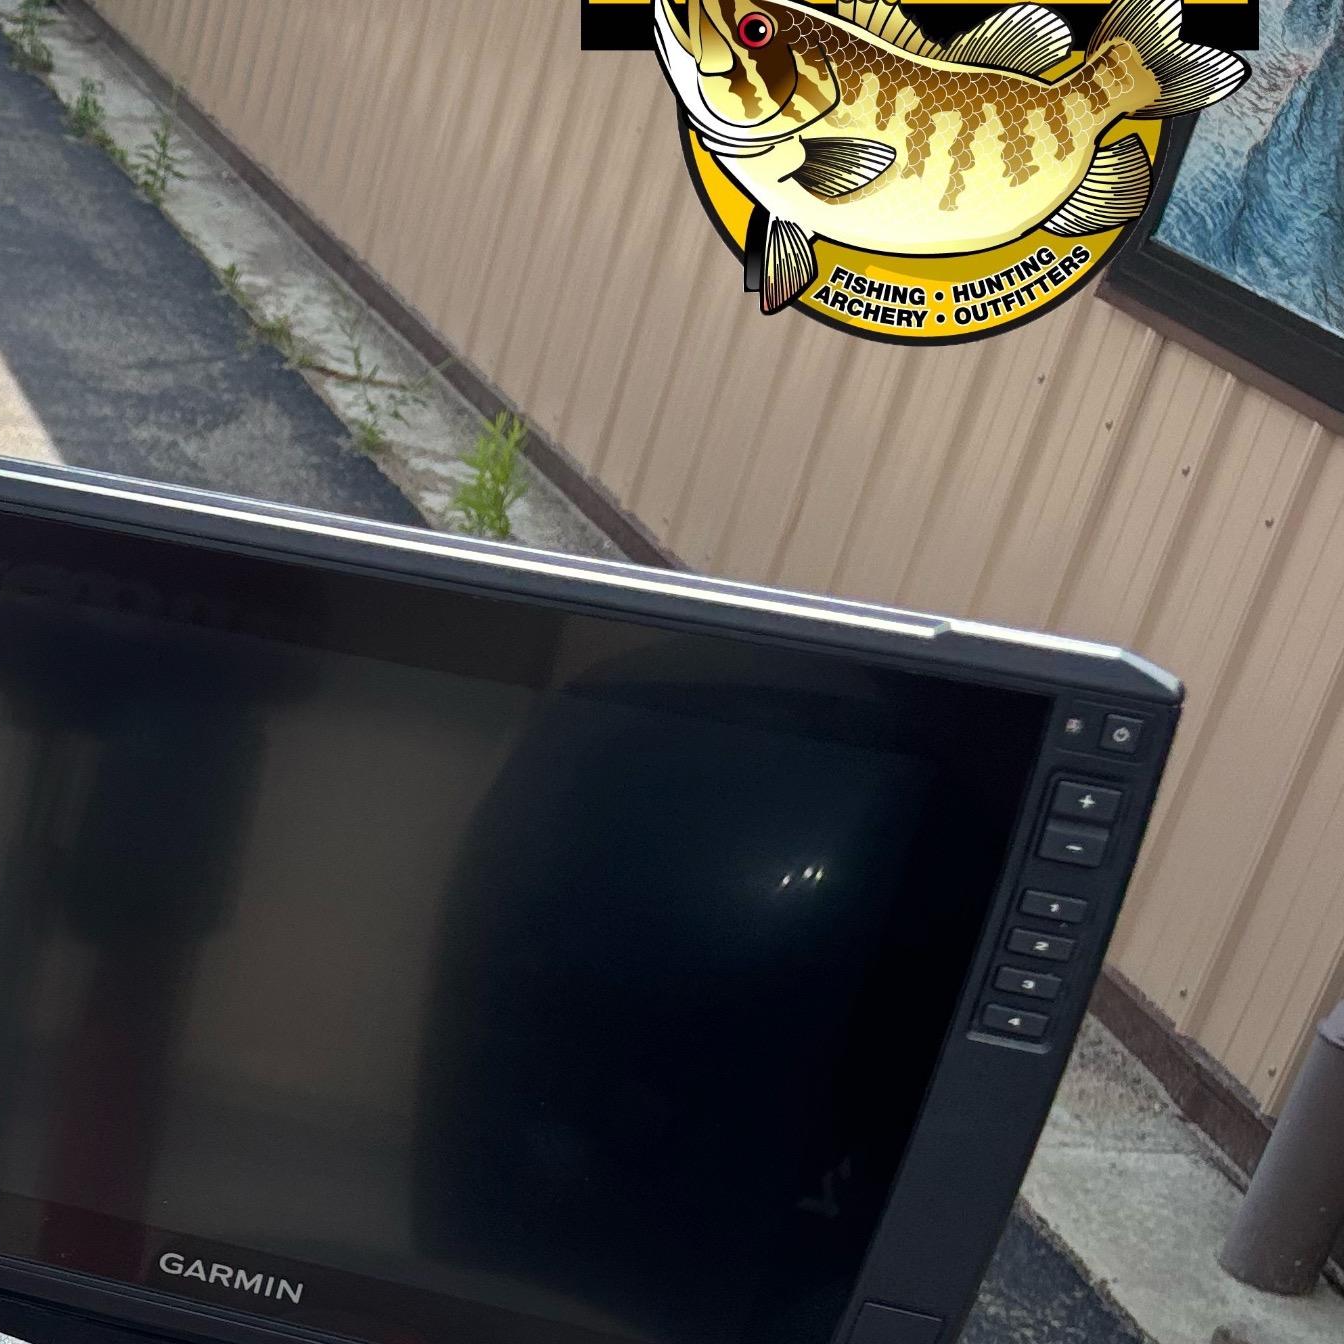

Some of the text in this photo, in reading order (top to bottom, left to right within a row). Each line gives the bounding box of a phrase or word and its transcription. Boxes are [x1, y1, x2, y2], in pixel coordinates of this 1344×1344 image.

[1034, 941, 1049, 951] 2
[1021, 980, 1035, 989] 3
[159, 1252, 304, 1304] GARMIN
